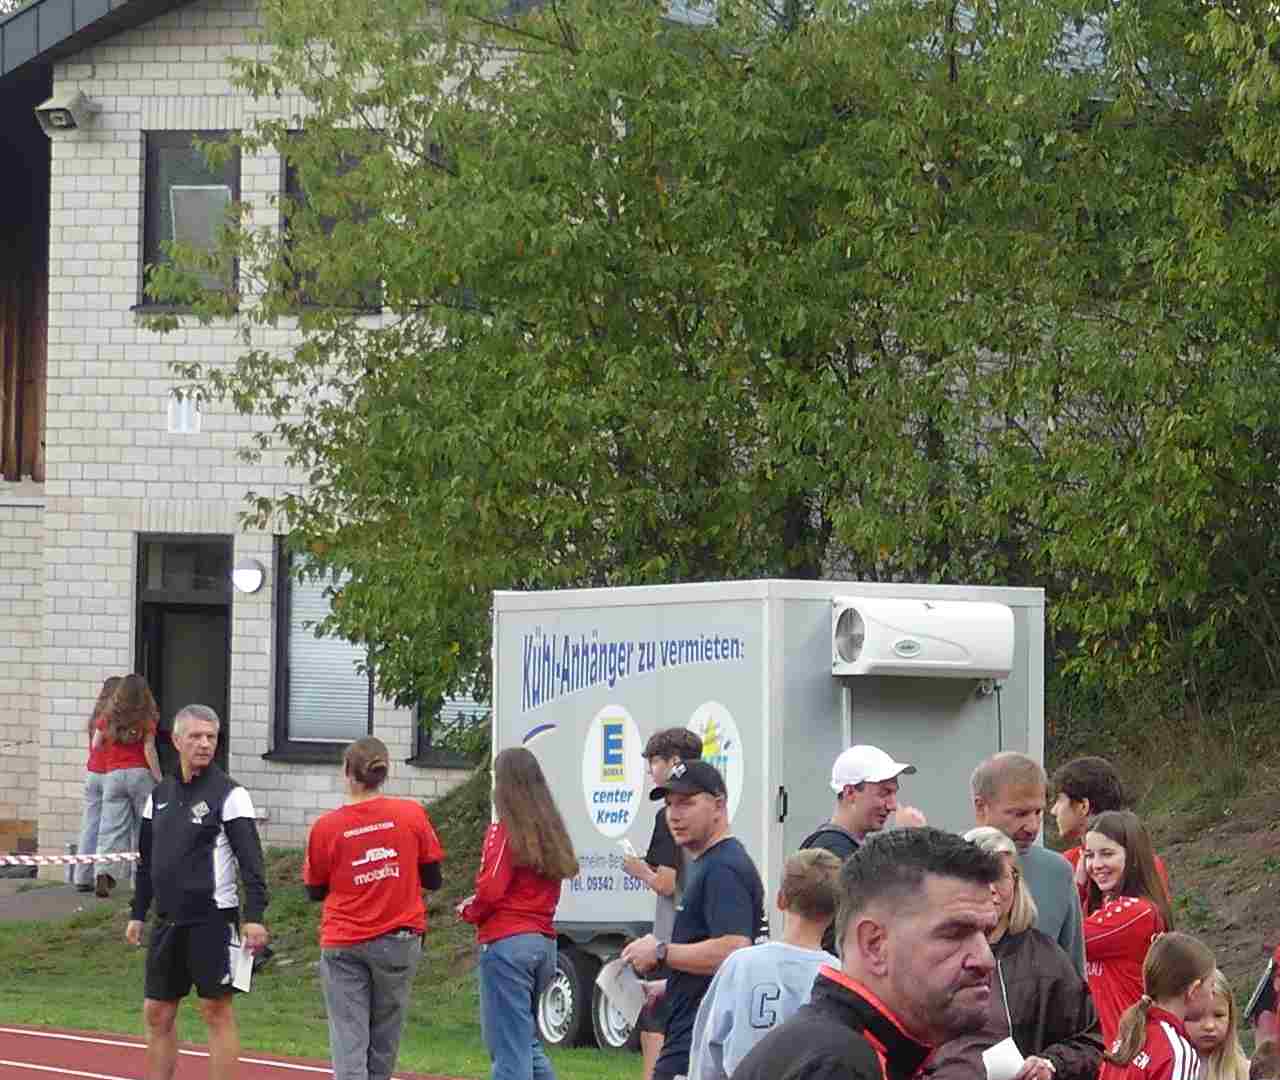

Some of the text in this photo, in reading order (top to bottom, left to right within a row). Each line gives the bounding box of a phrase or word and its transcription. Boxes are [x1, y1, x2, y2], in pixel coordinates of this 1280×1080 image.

[521, 625, 744, 713] Kühl-Anhänger zu vermieten:
[592, 788, 633, 804] center
[596, 809, 630, 824] Kraft
[586, 876, 614, 892] 09342
